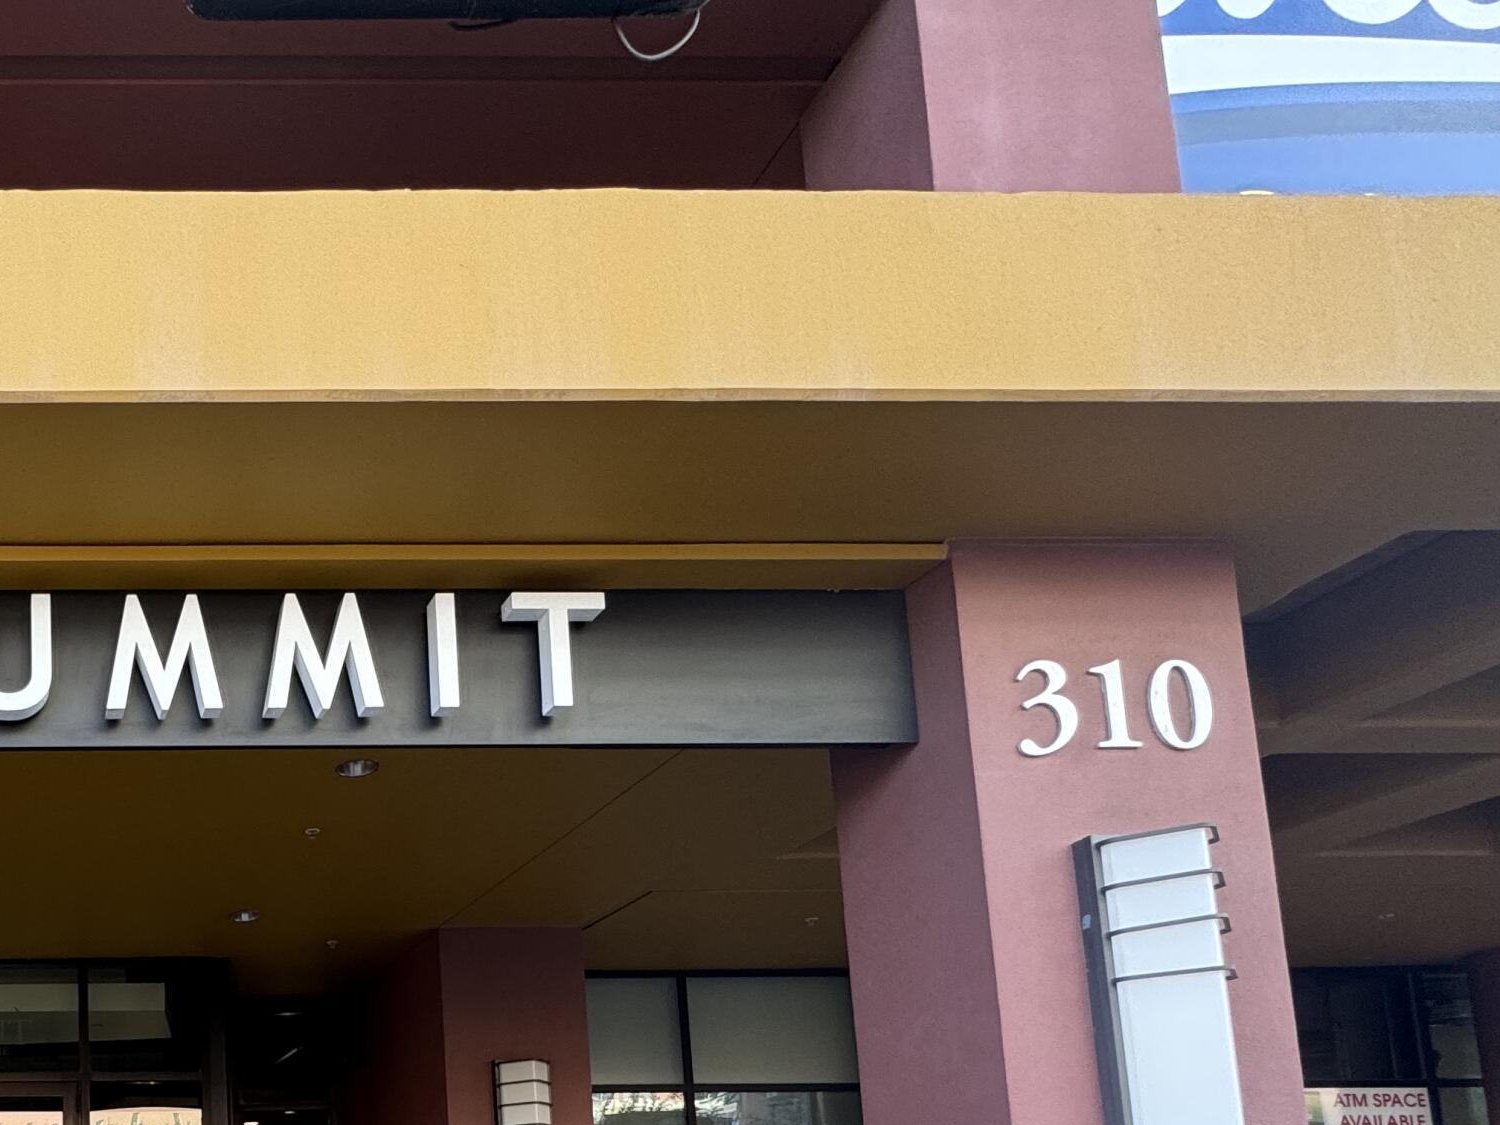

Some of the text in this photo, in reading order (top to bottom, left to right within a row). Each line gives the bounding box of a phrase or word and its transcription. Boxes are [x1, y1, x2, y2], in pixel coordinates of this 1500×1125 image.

[1014, 658, 1213, 758] 310
[1333, 1093, 1427, 1108] ATM SPACE
